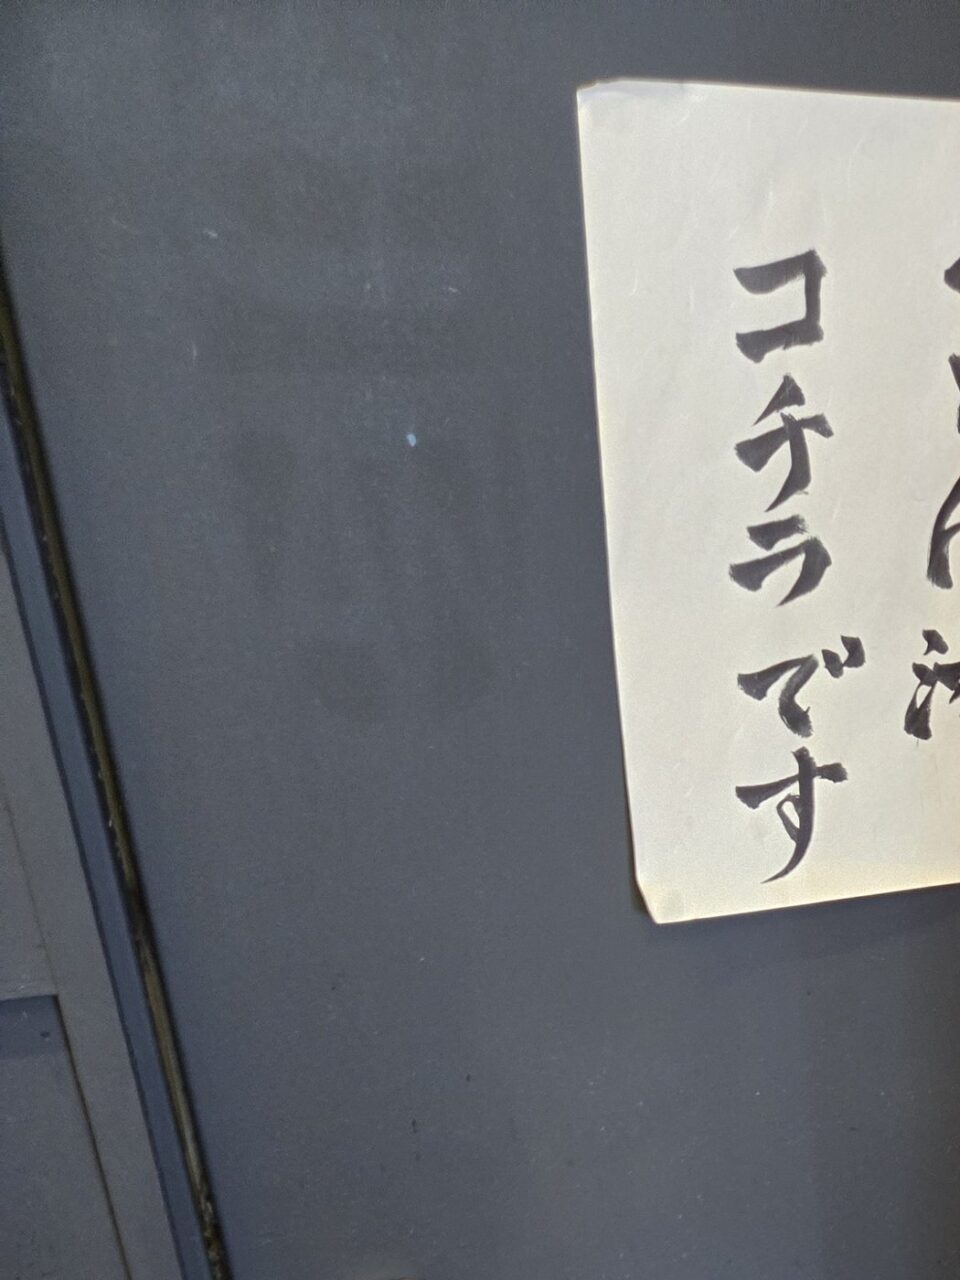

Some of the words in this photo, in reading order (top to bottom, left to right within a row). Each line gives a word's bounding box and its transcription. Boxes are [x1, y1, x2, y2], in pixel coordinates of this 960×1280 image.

[729, 248, 865, 884] コチラです
